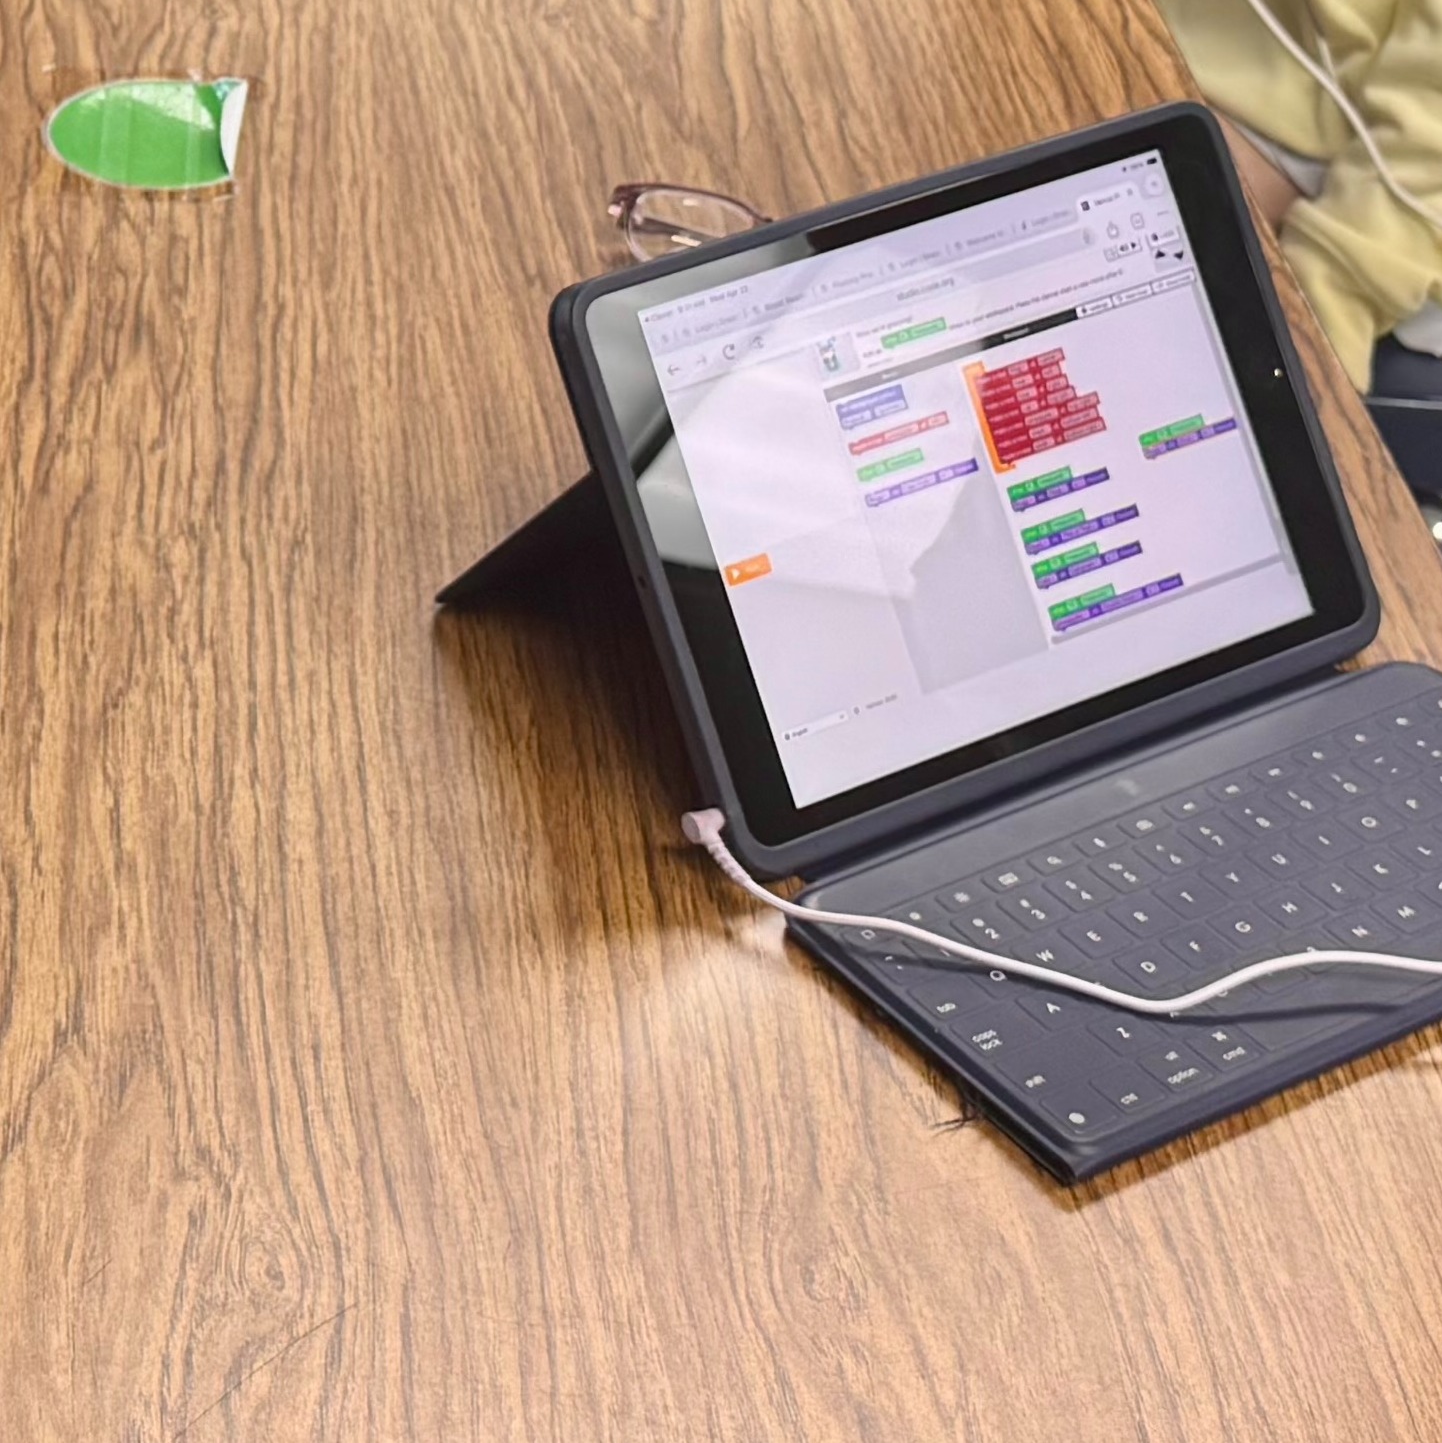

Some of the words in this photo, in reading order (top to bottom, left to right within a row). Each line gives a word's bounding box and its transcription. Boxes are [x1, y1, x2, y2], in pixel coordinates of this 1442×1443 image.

[984, 927, 1000, 940] 2
[989, 970, 1006, 982] Q
[1035, 949, 1055, 963] W
[1086, 930, 1102, 942] E
[1225, 871, 1240, 883] Y
[1271, 853, 1287, 865] U
[1351, 925, 1370, 938] N
[1397, 905, 1415, 919] M
[1046, 1002, 1062, 1014] A
[1234, 920, 1252, 933] G
[1281, 901, 1298, 914] H
